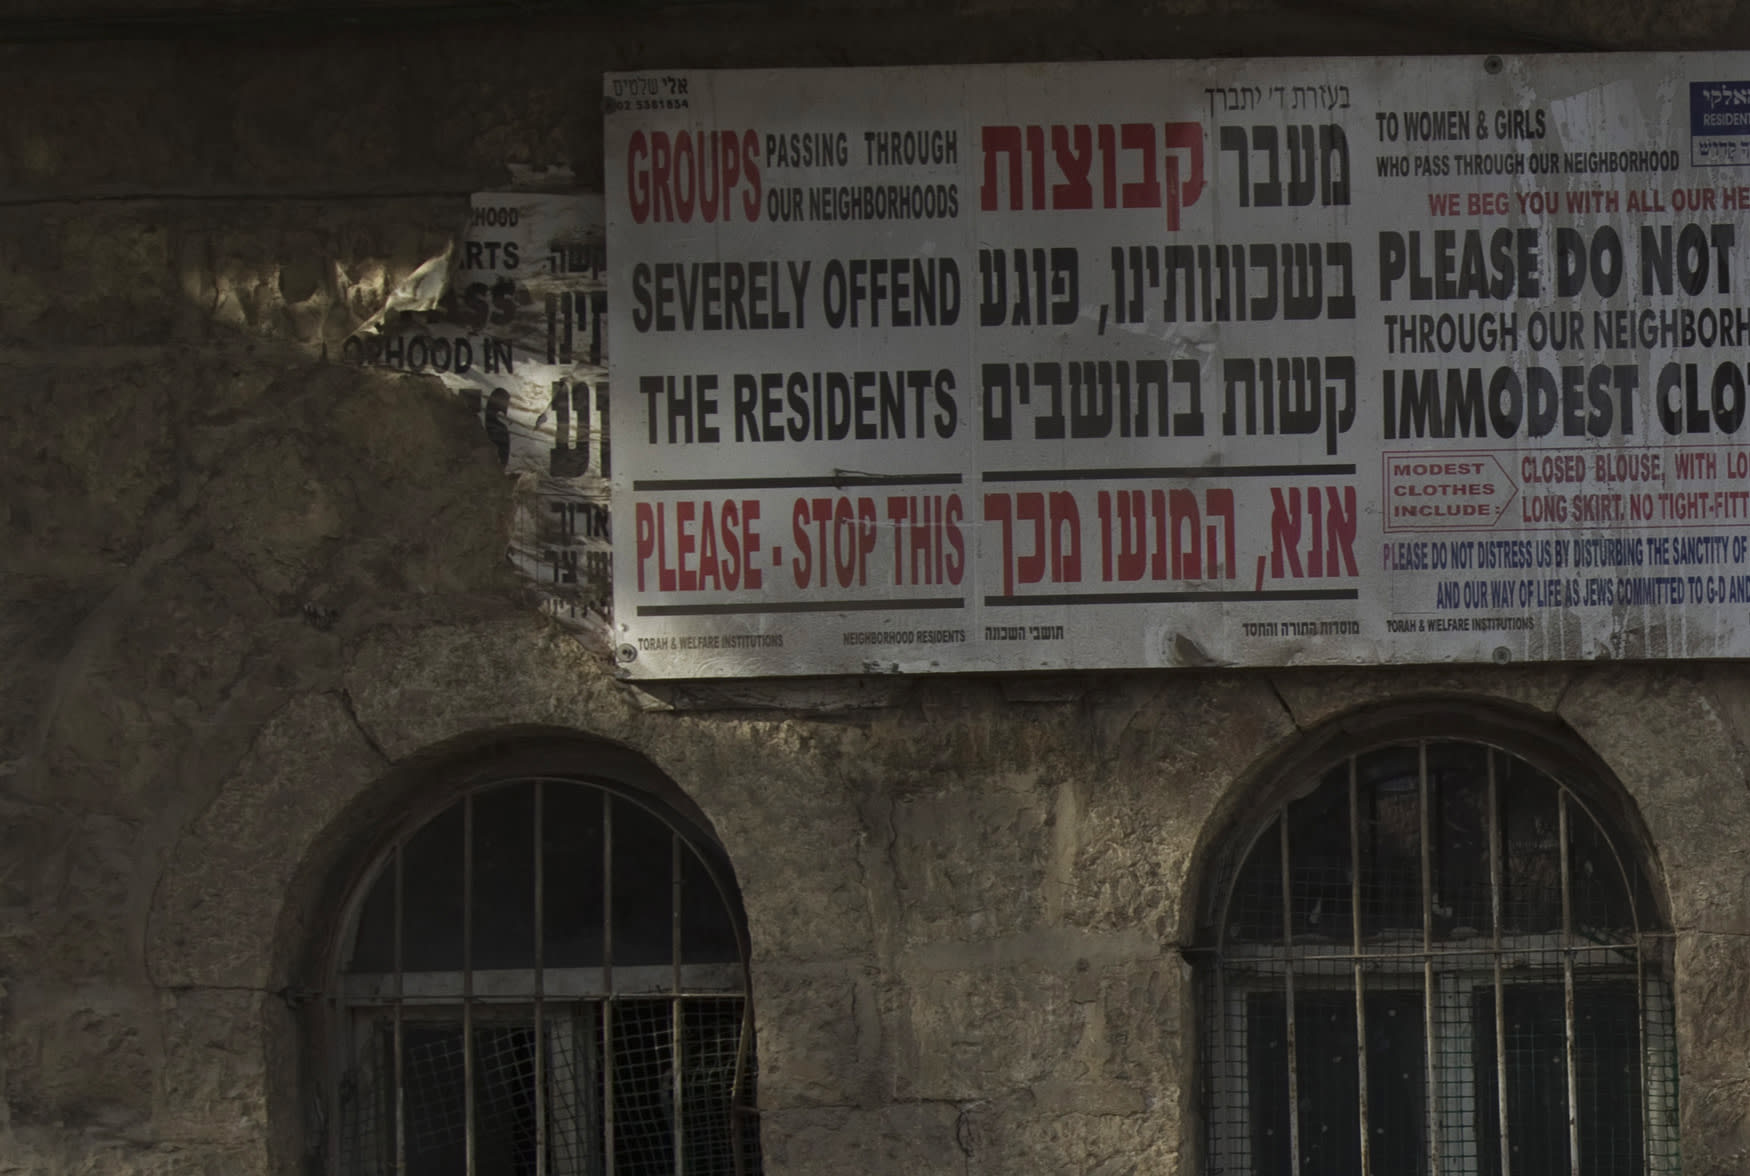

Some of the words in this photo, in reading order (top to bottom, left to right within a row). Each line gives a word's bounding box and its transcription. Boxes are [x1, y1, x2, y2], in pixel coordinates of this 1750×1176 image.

[1205, 87, 1261, 118] יתברך
[1292, 86, 1351, 110] בעזרת
[1376, 112, 1398, 142] TO
[1404, 111, 1470, 141] WOMEN
[1476, 110, 1489, 139] &
[1495, 108, 1545, 139] GIRLS
[627, 129, 763, 223] GROUPS
[766, 132, 849, 168] PASSING
[864, 130, 958, 166] THROUGH
[981, 121, 1207, 231] קבוצות
[1220, 123, 1351, 207] מעבר
[1376, 156, 1410, 177] WHO
[1414, 155, 1449, 176] PASS
[1454, 154, 1524, 175] THROUGH
[1529, 153, 1559, 174] OUR
[1564, 150, 1679, 173] NEIGHBORHOOD
[767, 187, 804, 222] OUR
[809, 184, 959, 220] NEIGHBORHOODS
[1428, 193, 1460, 216] WE
[1467, 192, 1510, 216] BEG
[1516, 192, 1558, 215] YOU
[1566, 190, 1619, 214] WITH
[1626, 189, 1664, 212] ALL
[1671, 187, 1719, 211] OUR
[980, 248, 1079, 326] פוגע
[1098, 242, 1356, 335] בשכונותינו,
[1379, 227, 1540, 301] PLEASE
[1557, 225, 1623, 298] DO
[1640, 223, 1735, 296] NOT
[632, 260, 811, 332] SEVERELY
[823, 258, 960, 328] OFFEND
[1384, 312, 1518, 353] THROUGH
[1528, 311, 1585, 351] OUR
[640, 375, 720, 444] THE
[734, 369, 958, 442] RESIDENTS
[982, 360, 1204, 440] בתושבים
[1222, 356, 1356, 456] קשות
[1382, 364, 1639, 440] IMMODEST
[1393, 463, 1485, 476] MODEST
[1393, 483, 1496, 497] CLOTHES
[1522, 455, 1586, 483] CLOSED
[1675, 452, 1717, 480] WITH
[1097, 488, 1236, 581] המנעו
[1522, 495, 1568, 522] LONG
[1573, 494, 1625, 521] SKIRT.
[1630, 493, 1652, 520] NO
[636, 499, 762, 592] PLEASE
[792, 496, 877, 589] STOP
[887, 493, 965, 586] THIS
[984, 490, 1082, 597] מכך
[1256, 486, 1359, 592] אנא,
[1383, 543, 1428, 570] PLEASE
[1431, 542, 1446, 569] DO
[1451, 541, 1474, 569] NOT
[1478, 540, 1532, 569] DISTRESS
[1536, 540, 1551, 567] US
[1555, 539, 1570, 567] BY
[1574, 537, 1643, 567] DISTURBING
[1646, 537, 1669, 565] THE
[1673, 536, 1729, 564] SANCTITY
[1733, 536, 1747, 563] OF
[638, 637, 668, 651] TORAH
[680, 634, 719, 650] WELFARE
[721, 633, 783, 649] INSTITUTIONS
[843, 631, 915, 646] NEIGHBORHOOD
[916, 629, 965, 644] RESIDENTS
